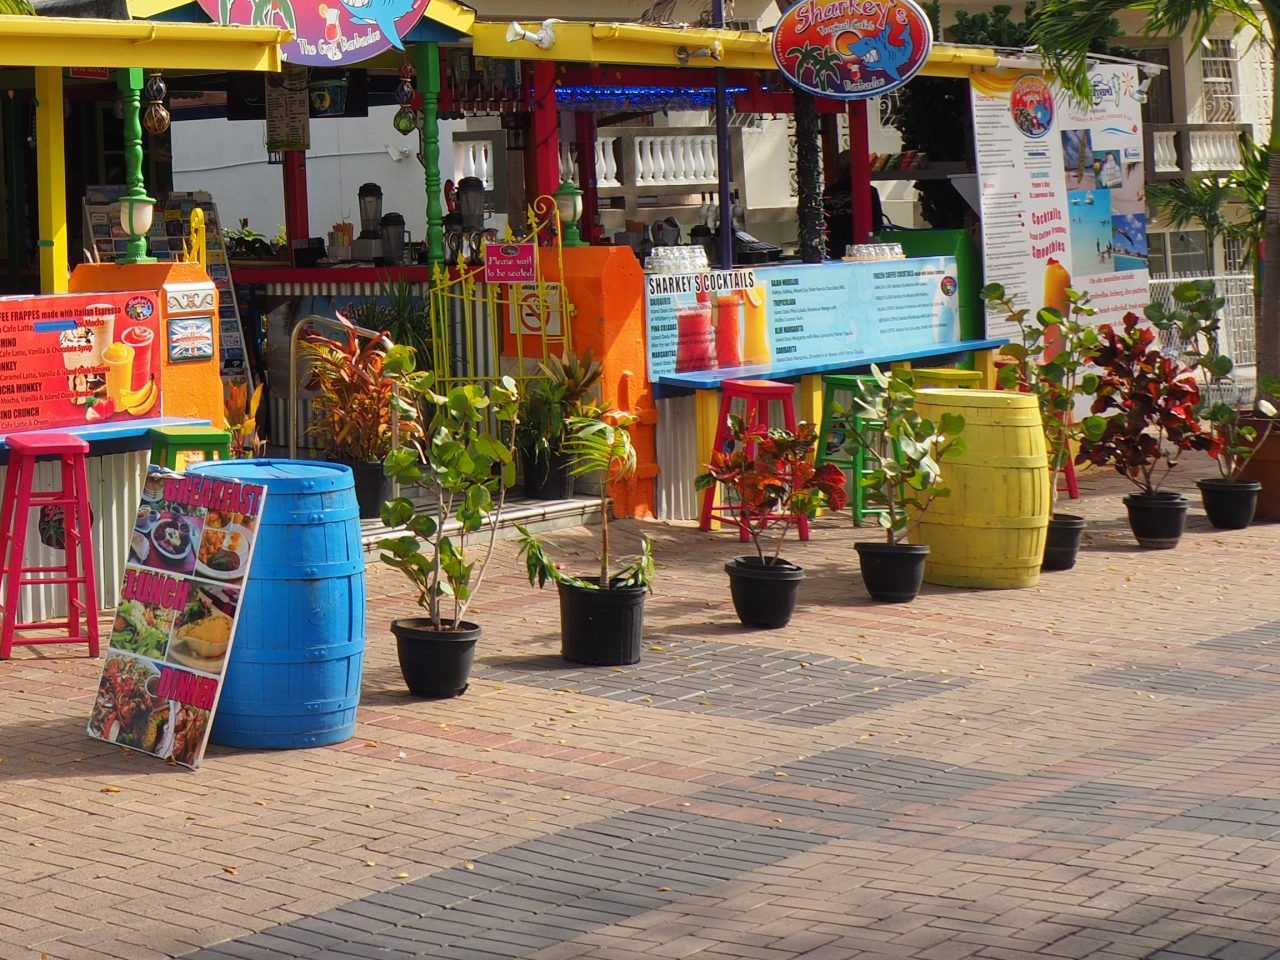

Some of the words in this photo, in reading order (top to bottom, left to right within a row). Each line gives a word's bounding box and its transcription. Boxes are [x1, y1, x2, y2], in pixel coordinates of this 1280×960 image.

[296, 37, 317, 56] The
[339, 27, 381, 52] Barbados
[843, 76, 885, 91] Barbados
[1031, 208, 1061, 225] Cocktails
[1032, 240, 1065, 259] Smoothies
[488, 256, 513, 265] Please
[517, 255, 532, 265] wait
[487, 268, 494, 276] to
[649, 274, 701, 295] SHARKEY'S
[703, 271, 754, 291] COCKTAILS
[10, 310, 40, 322] FRAPPES
[41, 309, 58, 319] made
[59, 308, 73, 318] with
[74, 307, 94, 317] Italian
[94, 306, 121, 317] Espresso
[2, 325, 17, 333] Cafe
[85, 319, 105, 327] Mocha
[0, 350, 11, 358] Cafe
[28, 347, 45, 355] Vanilla
[52, 345, 77, 353] Chocolate
[78, 344, 93, 353] Syrup
[652, 350, 676, 358] MARGARITAS
[0, 373, 21, 381] Caramel
[38, 370, 55, 378] Vanilla
[16, 382, 42, 393] MONKEY
[20, 394, 38, 402] Vanilla
[13, 406, 40, 418] CRUNCH
[162, 474, 265, 517] BREAKFAST
[124, 568, 190, 612] LUNCH
[156, 666, 220, 710] DINNER
